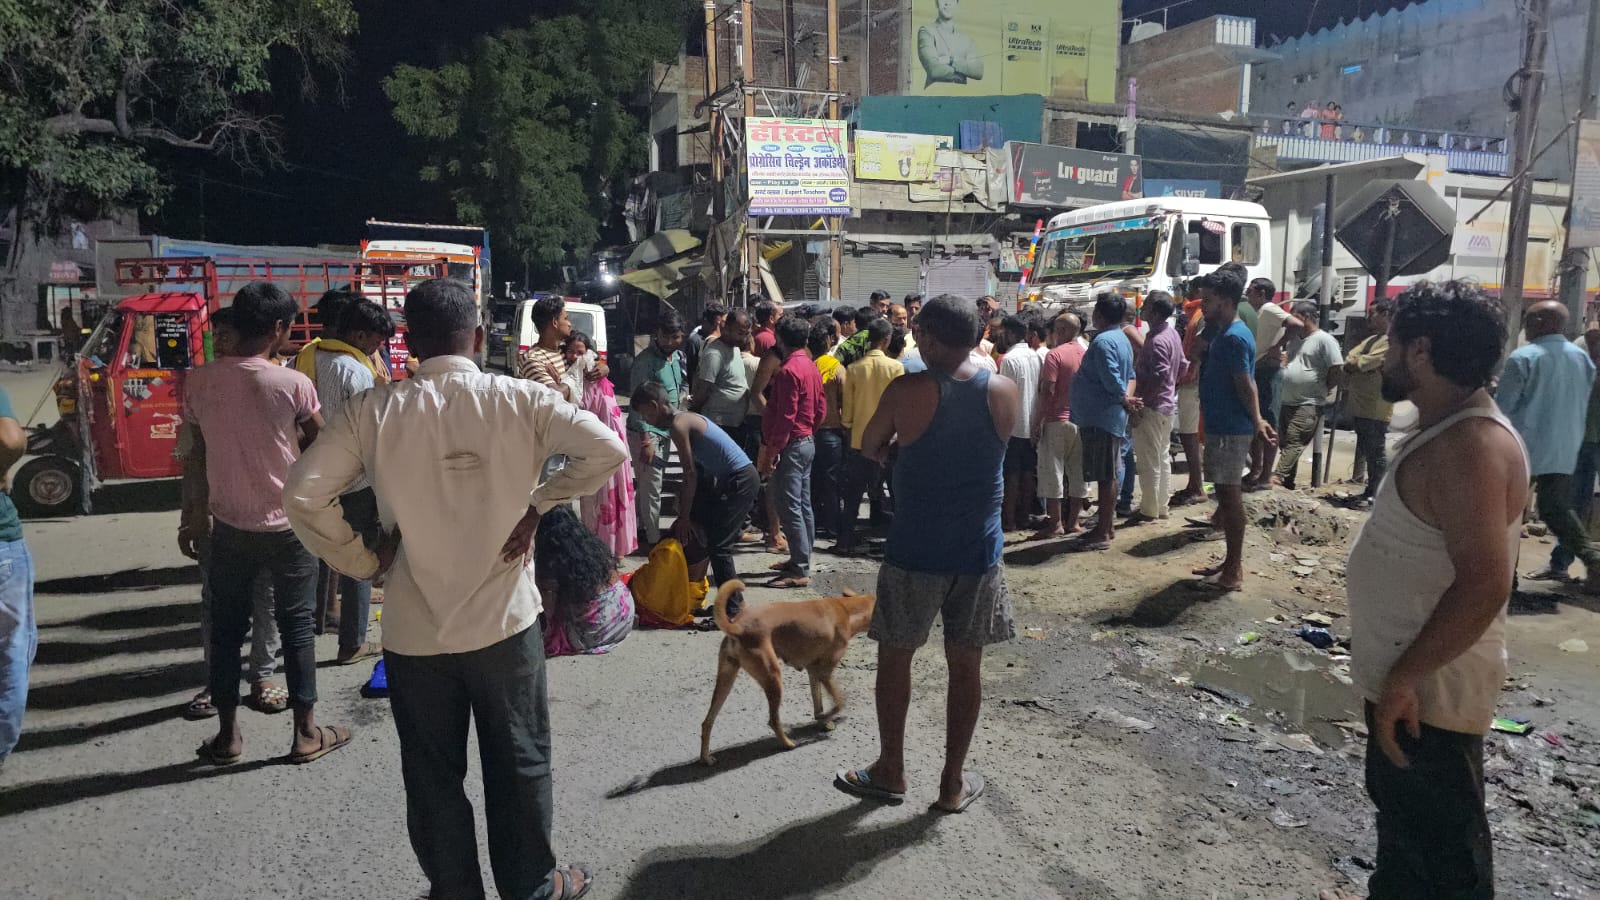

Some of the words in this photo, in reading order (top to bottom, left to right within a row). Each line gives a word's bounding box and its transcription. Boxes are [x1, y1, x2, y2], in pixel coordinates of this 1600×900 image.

[1008, 37, 1042, 46] UltraTech
[746, 119, 844, 143] हॉस्टल
[1057, 161, 1119, 184] Livguard
[1174, 189, 1206, 198] SILVER
